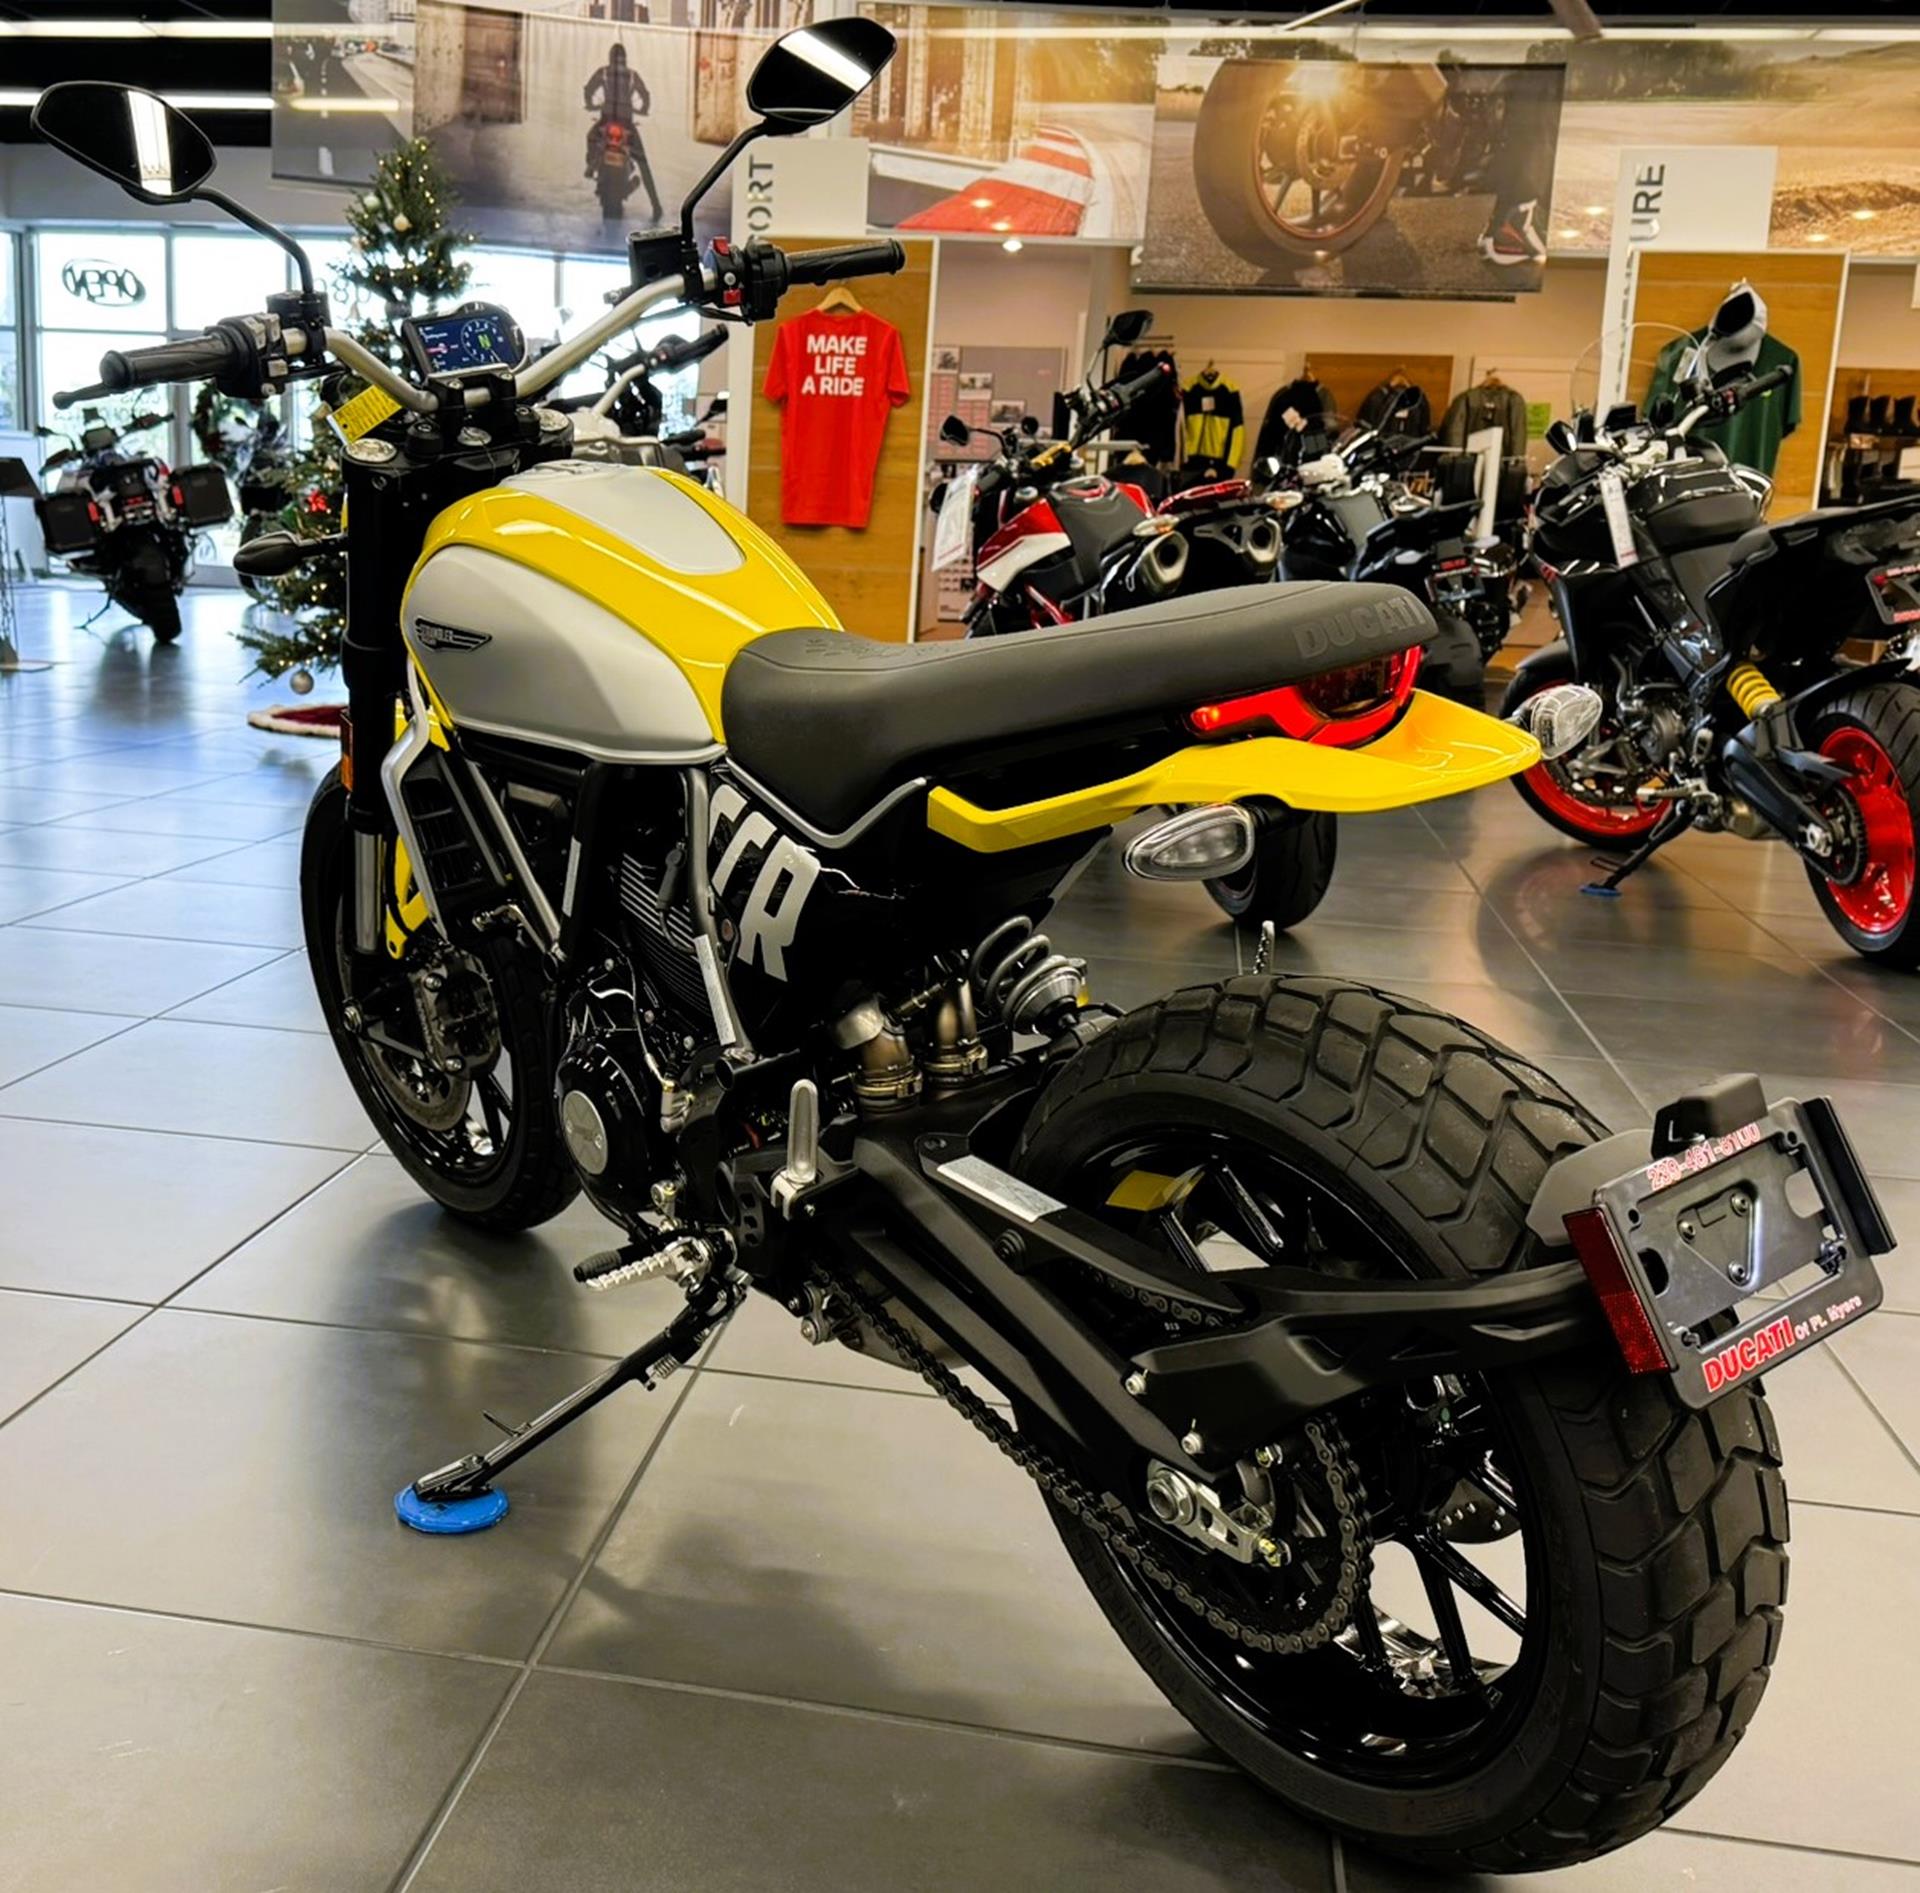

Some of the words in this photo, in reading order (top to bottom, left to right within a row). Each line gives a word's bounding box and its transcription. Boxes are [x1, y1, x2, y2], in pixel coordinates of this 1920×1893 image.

[747, 154, 773, 231] ORT
[806, 334, 868, 356] MAKE
[814, 355, 857, 375] LIFE
[801, 375, 816, 395] A
[819, 376, 865, 397] RIDE
[1292, 596, 1426, 659] DUCATI
[1702, 1315, 1796, 1393] DUCATI
